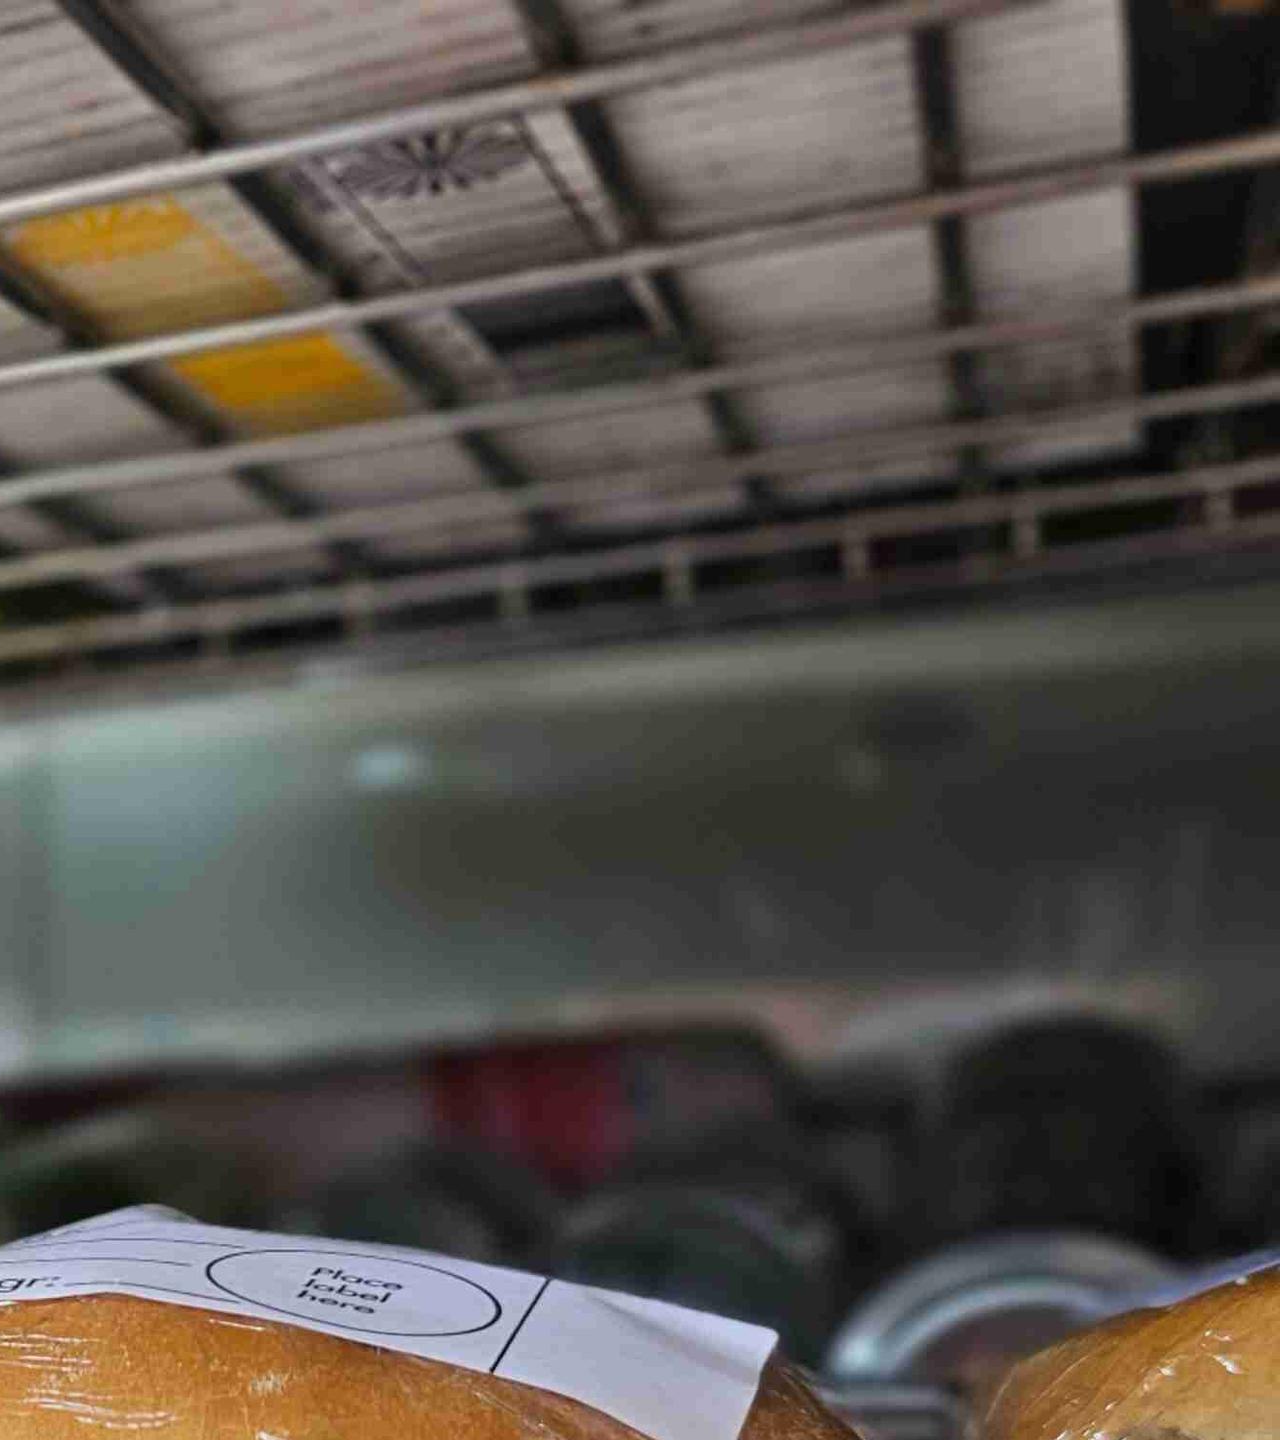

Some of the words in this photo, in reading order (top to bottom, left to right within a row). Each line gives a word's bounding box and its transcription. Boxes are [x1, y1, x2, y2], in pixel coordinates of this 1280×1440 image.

[302, 1278, 393, 1304] label
[310, 1266, 404, 1291] Place
[296, 1289, 375, 1315] here
